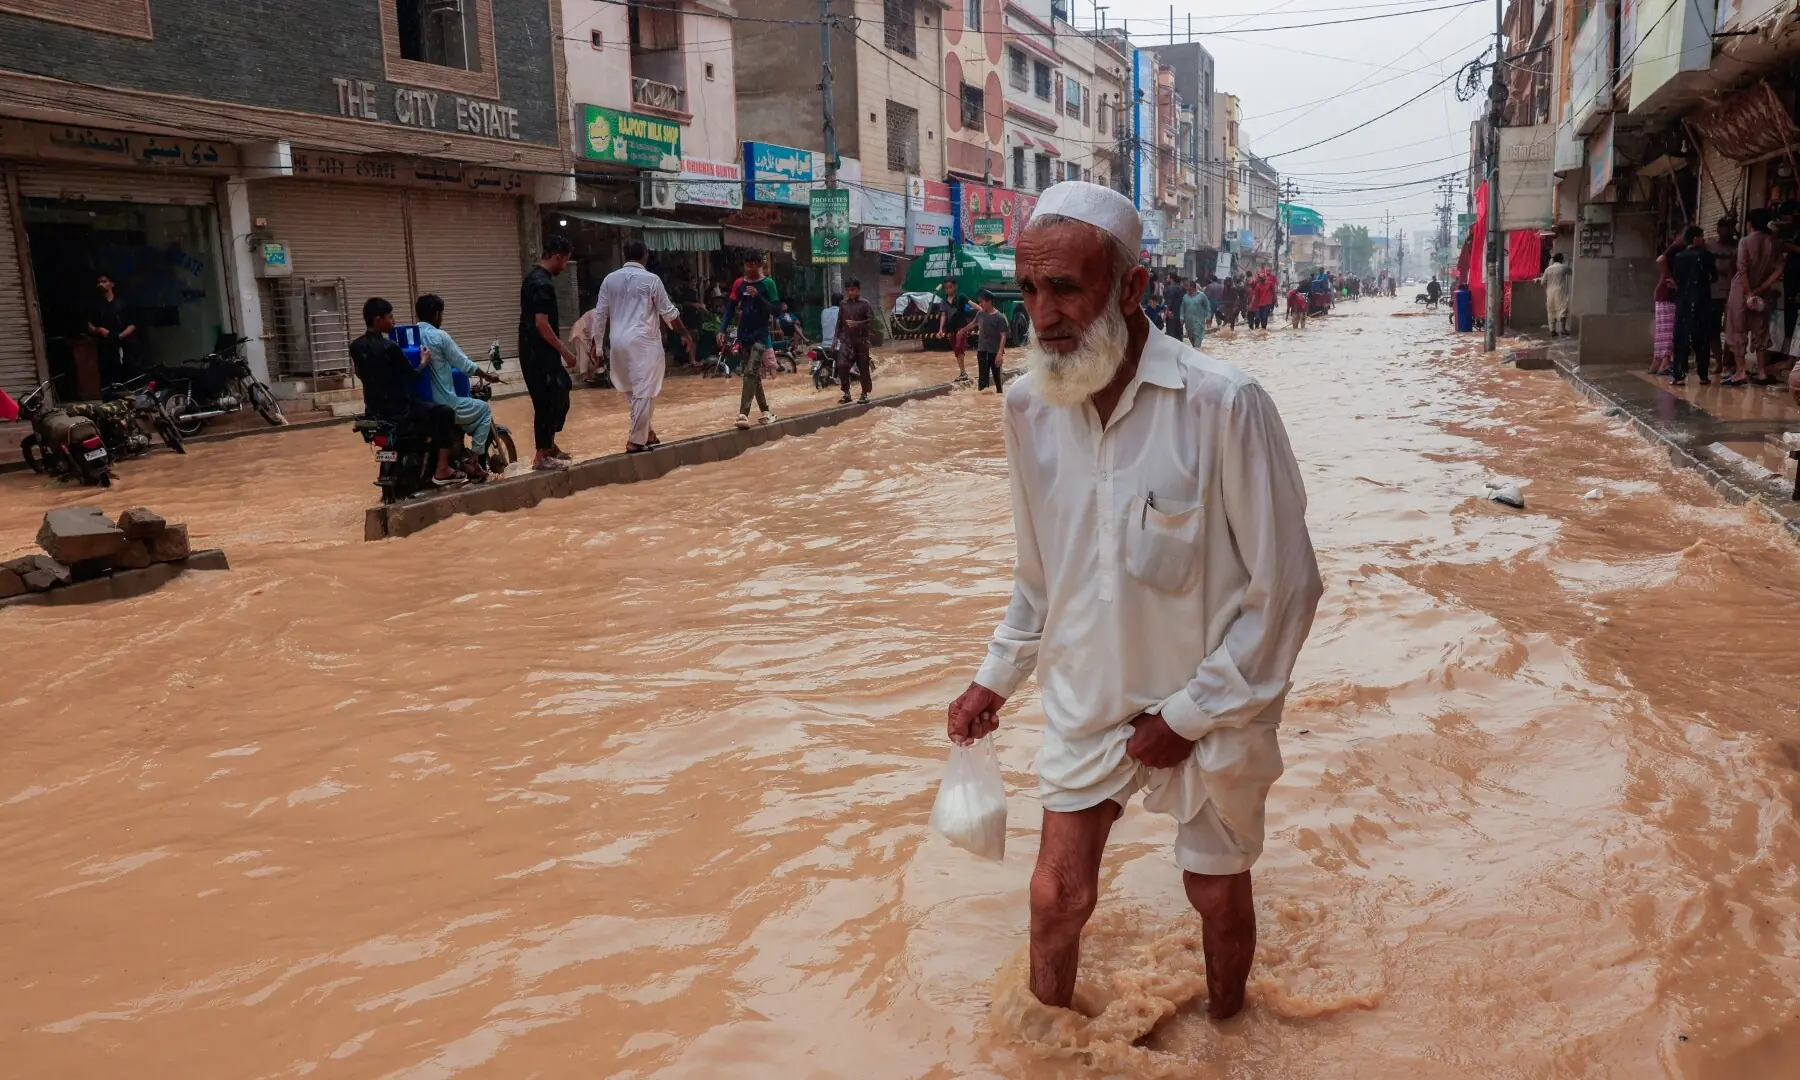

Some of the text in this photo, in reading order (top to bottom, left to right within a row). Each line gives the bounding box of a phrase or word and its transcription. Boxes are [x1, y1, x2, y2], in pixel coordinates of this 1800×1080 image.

[332, 77, 520, 140] THE CITY ESTATE
[647, 121, 662, 142] MILK
[662, 125, 679, 145] SHOP
[293, 153, 397, 179] HE CITY ESTATE
